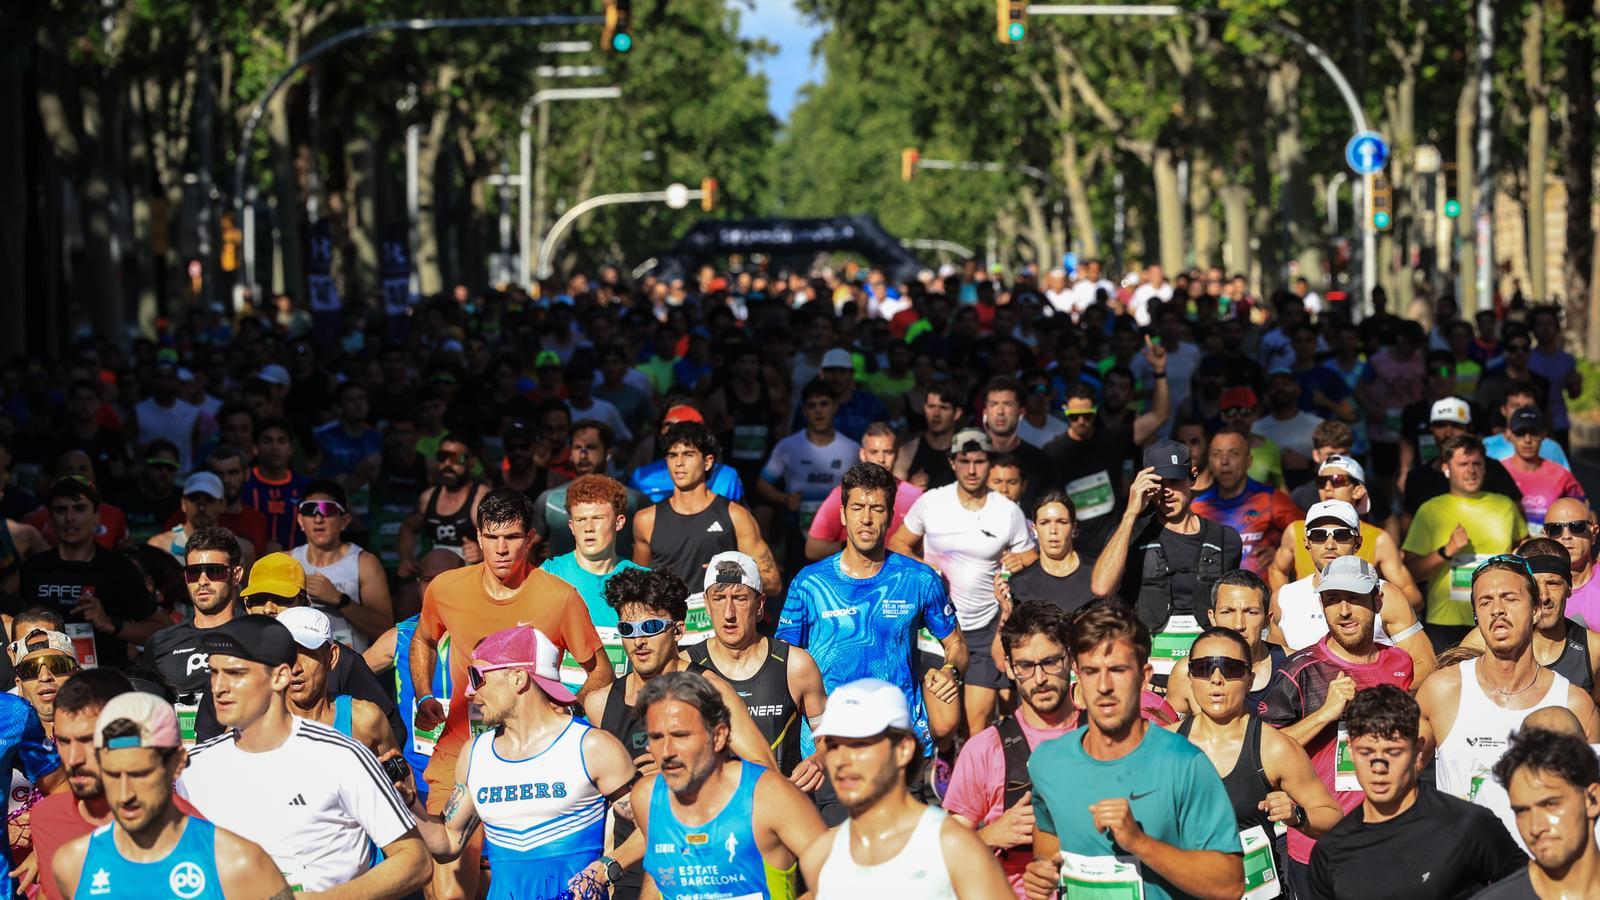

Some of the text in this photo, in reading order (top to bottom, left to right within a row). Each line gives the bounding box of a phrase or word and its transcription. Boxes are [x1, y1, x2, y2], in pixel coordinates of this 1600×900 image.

[38, 584, 82, 598] SAFE
[821, 607, 858, 619] BROOKS
[476, 781, 568, 805] CHEERS
[678, 865, 719, 877] ESTATE
[679, 873, 747, 887] BARCELONA
